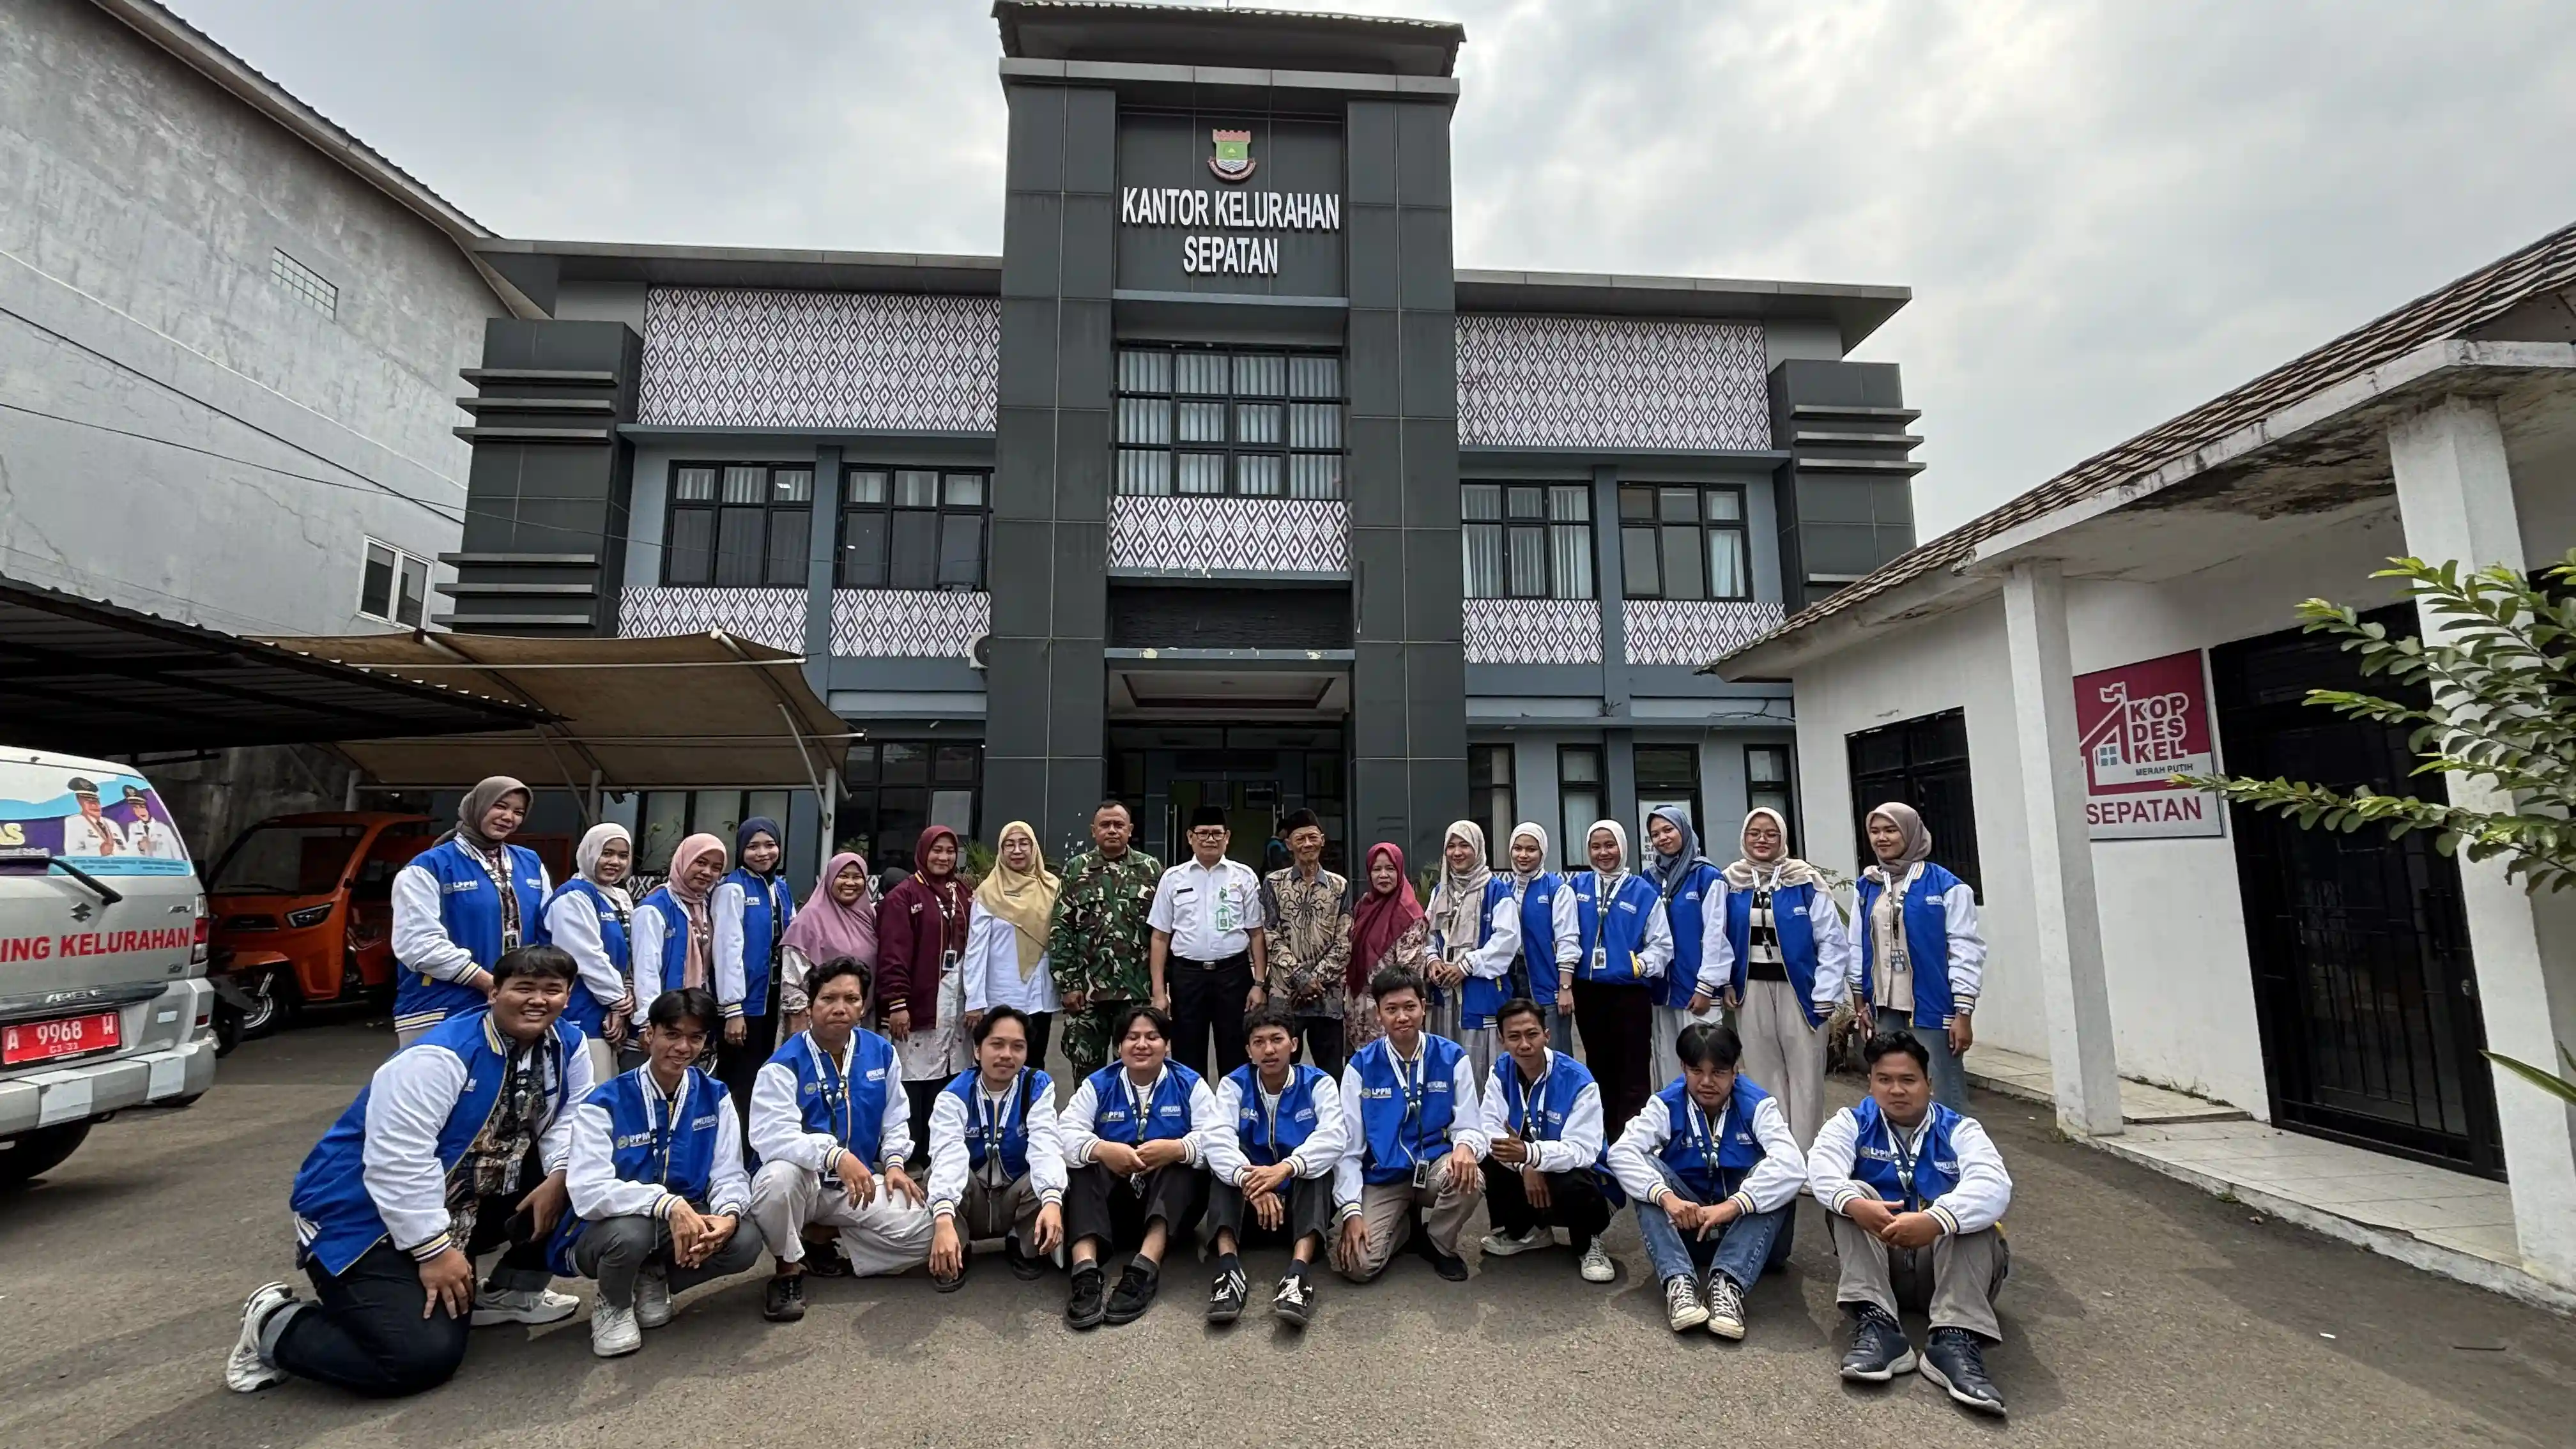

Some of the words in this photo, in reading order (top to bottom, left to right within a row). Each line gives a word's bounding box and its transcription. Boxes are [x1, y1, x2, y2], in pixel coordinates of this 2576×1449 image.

[1121, 187, 1209, 226] KANTOR
[1215, 190, 1340, 229] KELURAHAN
[1183, 235, 1278, 274] SEPATAN
[2129, 694, 2186, 723] KOP
[2132, 717, 2184, 743] DES
[2134, 740, 2186, 763] KEL
[2136, 767, 2165, 776] MERAH
[2167, 763, 2193, 772] PUTIH
[2086, 796, 2202, 825] SEPATAN
[59, 927, 190, 958] KELURAHAN
[7, 1029, 19, 1050] A
[36, 1020, 83, 1045] 9968
